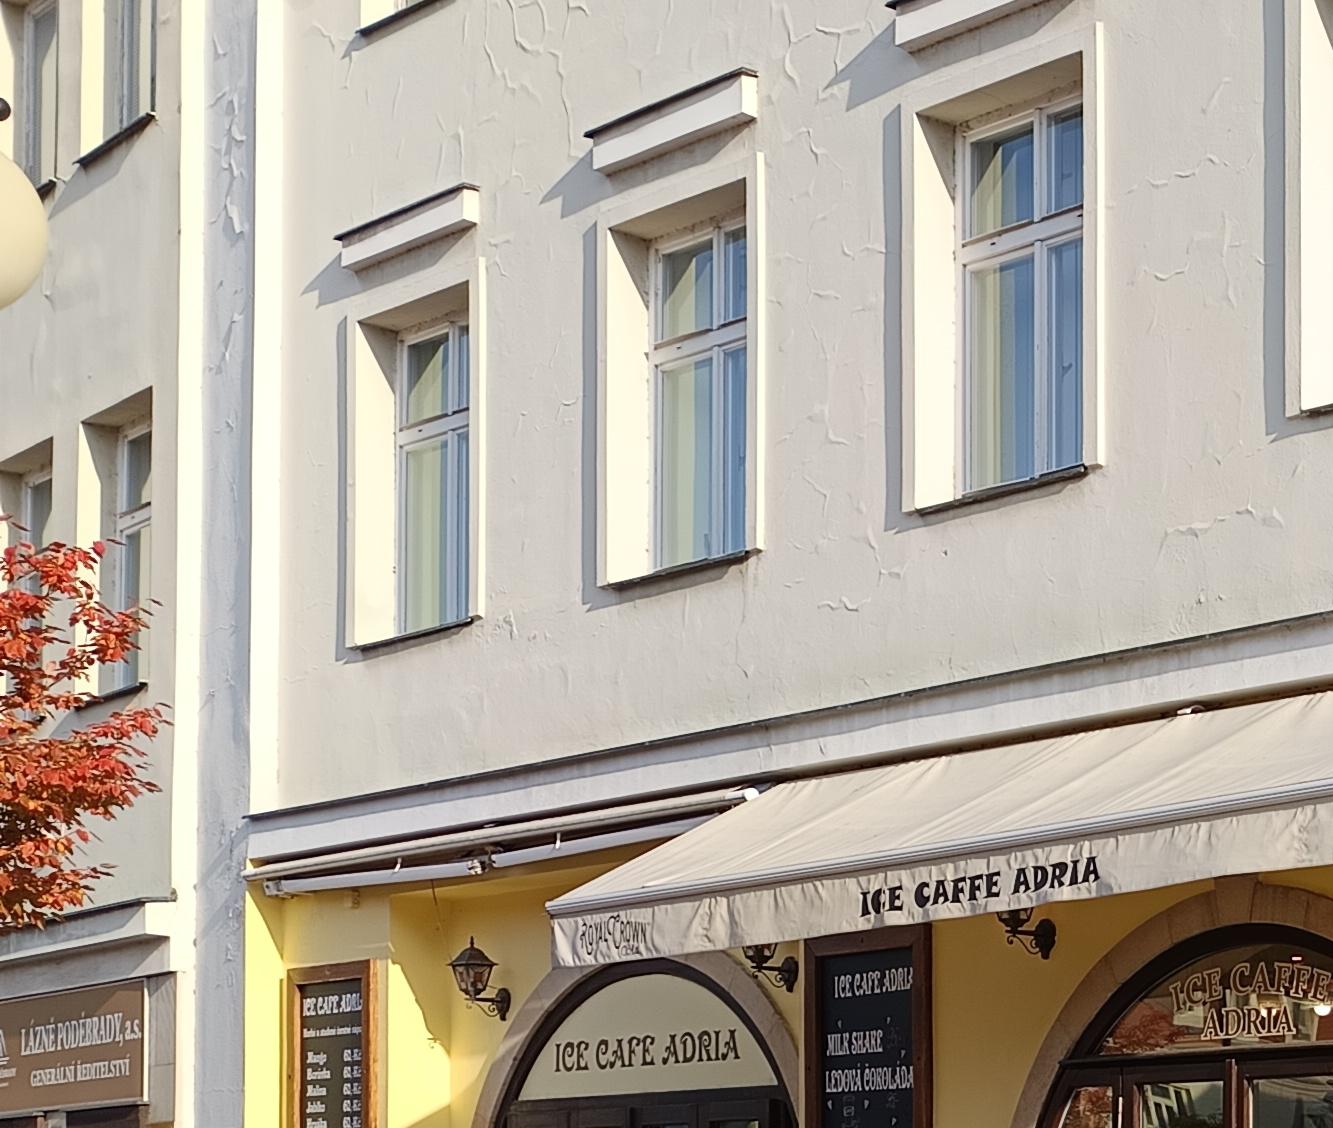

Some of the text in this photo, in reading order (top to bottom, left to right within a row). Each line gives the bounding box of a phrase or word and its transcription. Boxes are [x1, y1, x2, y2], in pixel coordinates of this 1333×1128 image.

[859, 855, 1101, 917] ICE CAFFE ADRIA
[834, 974, 853, 999] ICE
[853, 970, 881, 997] CAFE
[1169, 961, 1332, 1013] ICE CAFFE
[1201, 1004, 1297, 1040] ADRIA
[554, 1028, 741, 1073] ICE CAFE ADRIA
[826, 1032, 850, 1057] MILK
[851, 1029, 883, 1055] SHAKE
[825, 1060, 914, 1093] LEDOVÁ ČOKOLÁDA
